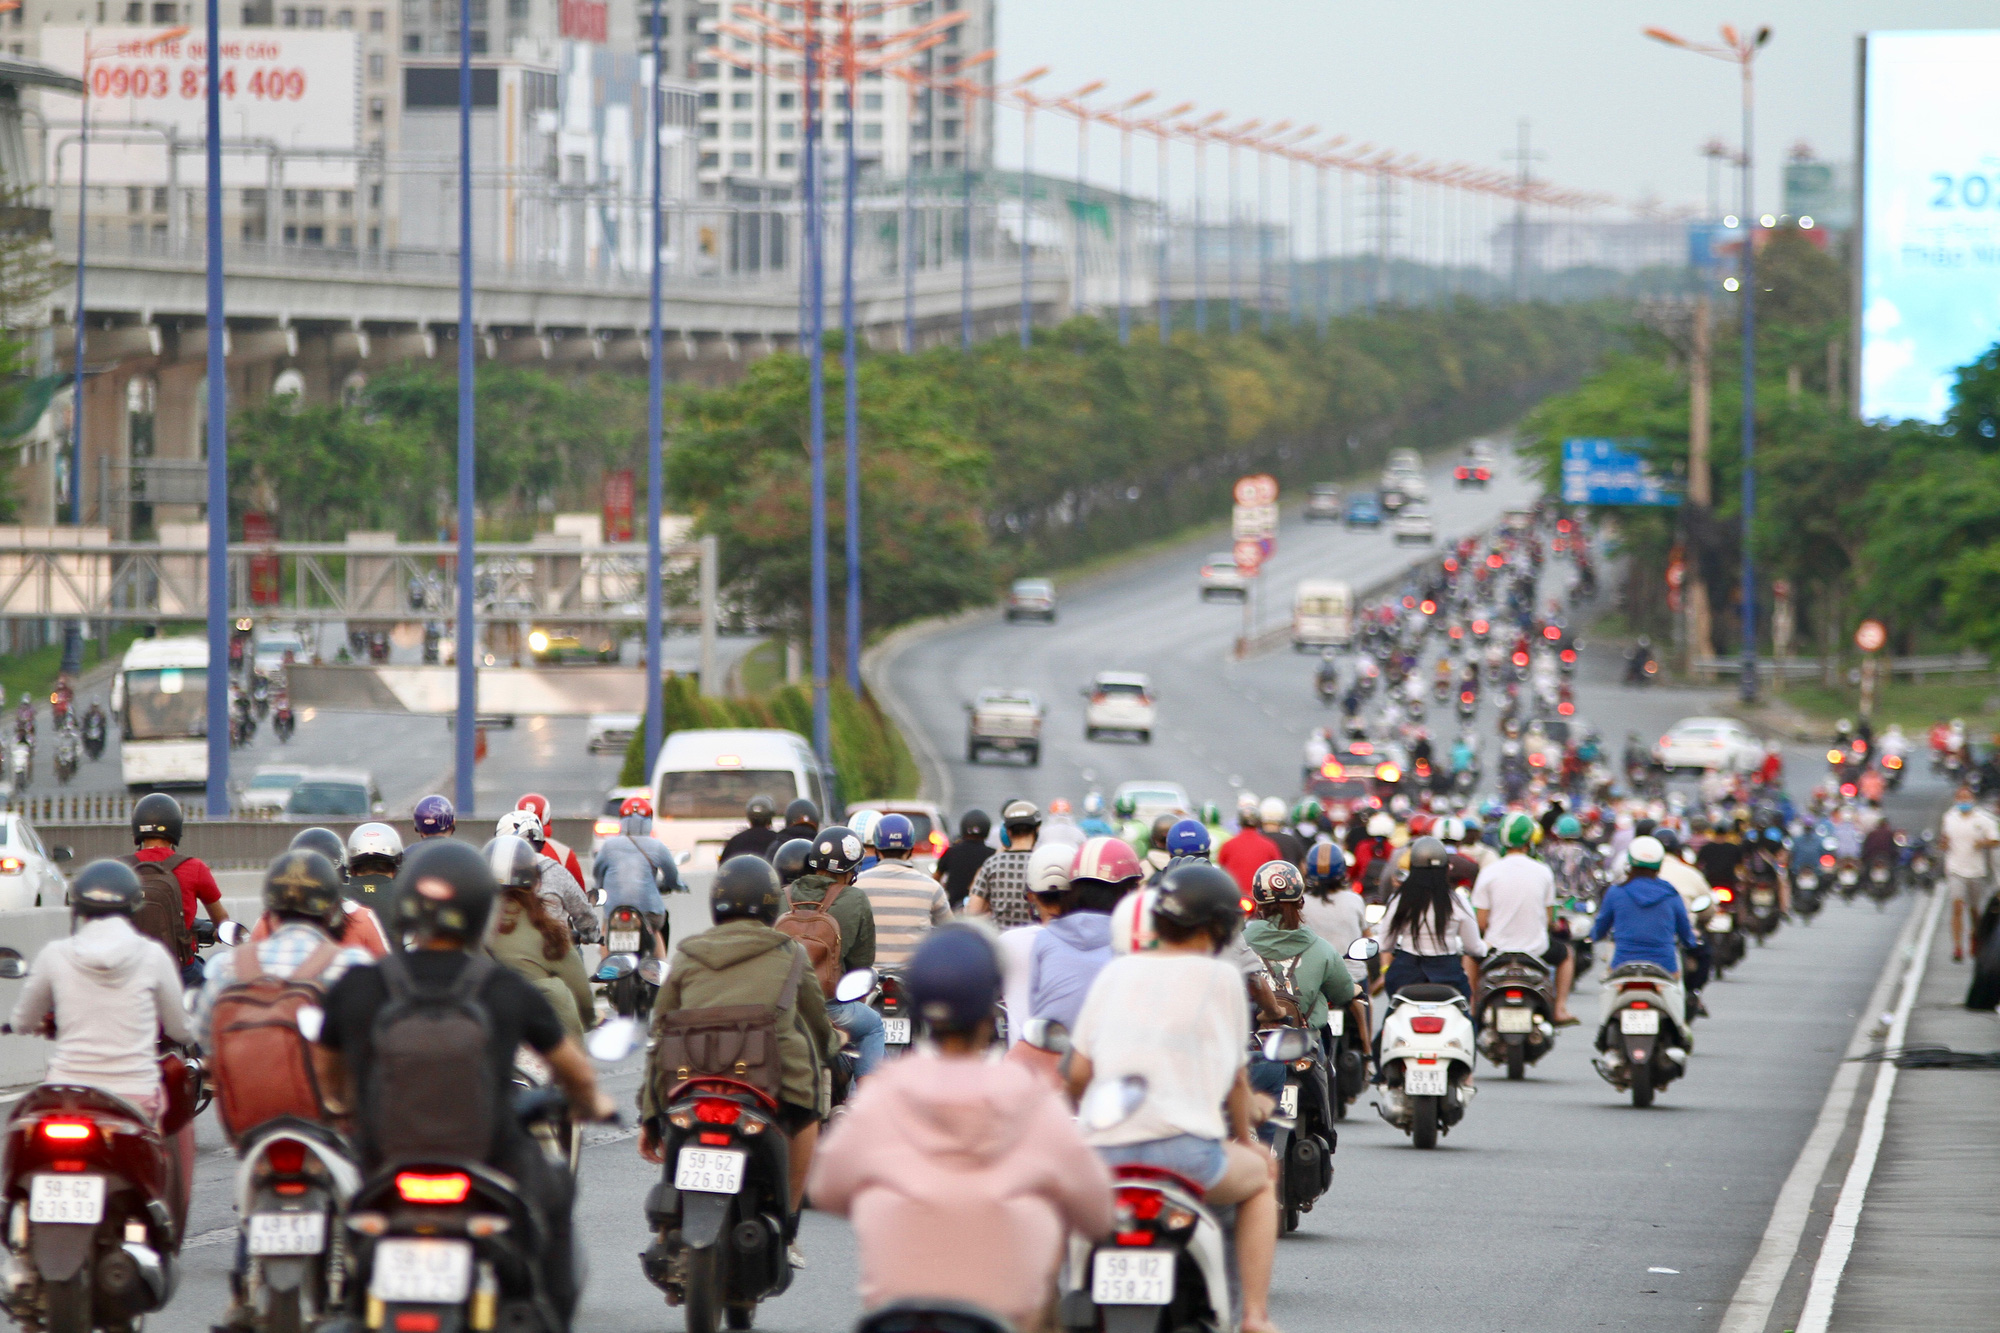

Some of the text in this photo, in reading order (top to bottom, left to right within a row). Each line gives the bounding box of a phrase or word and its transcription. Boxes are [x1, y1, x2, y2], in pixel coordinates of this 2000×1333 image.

[92, 66, 168, 98] 0903
[247, 67, 305, 101] 409
[1929, 172, 2000, 211] 20
[689, 1152, 733, 1171] 59-G2
[680, 1170, 735, 1190] 226.96
[1107, 1258, 1160, 1277] 59-U2
[1099, 1280, 1163, 1300] 358.21
